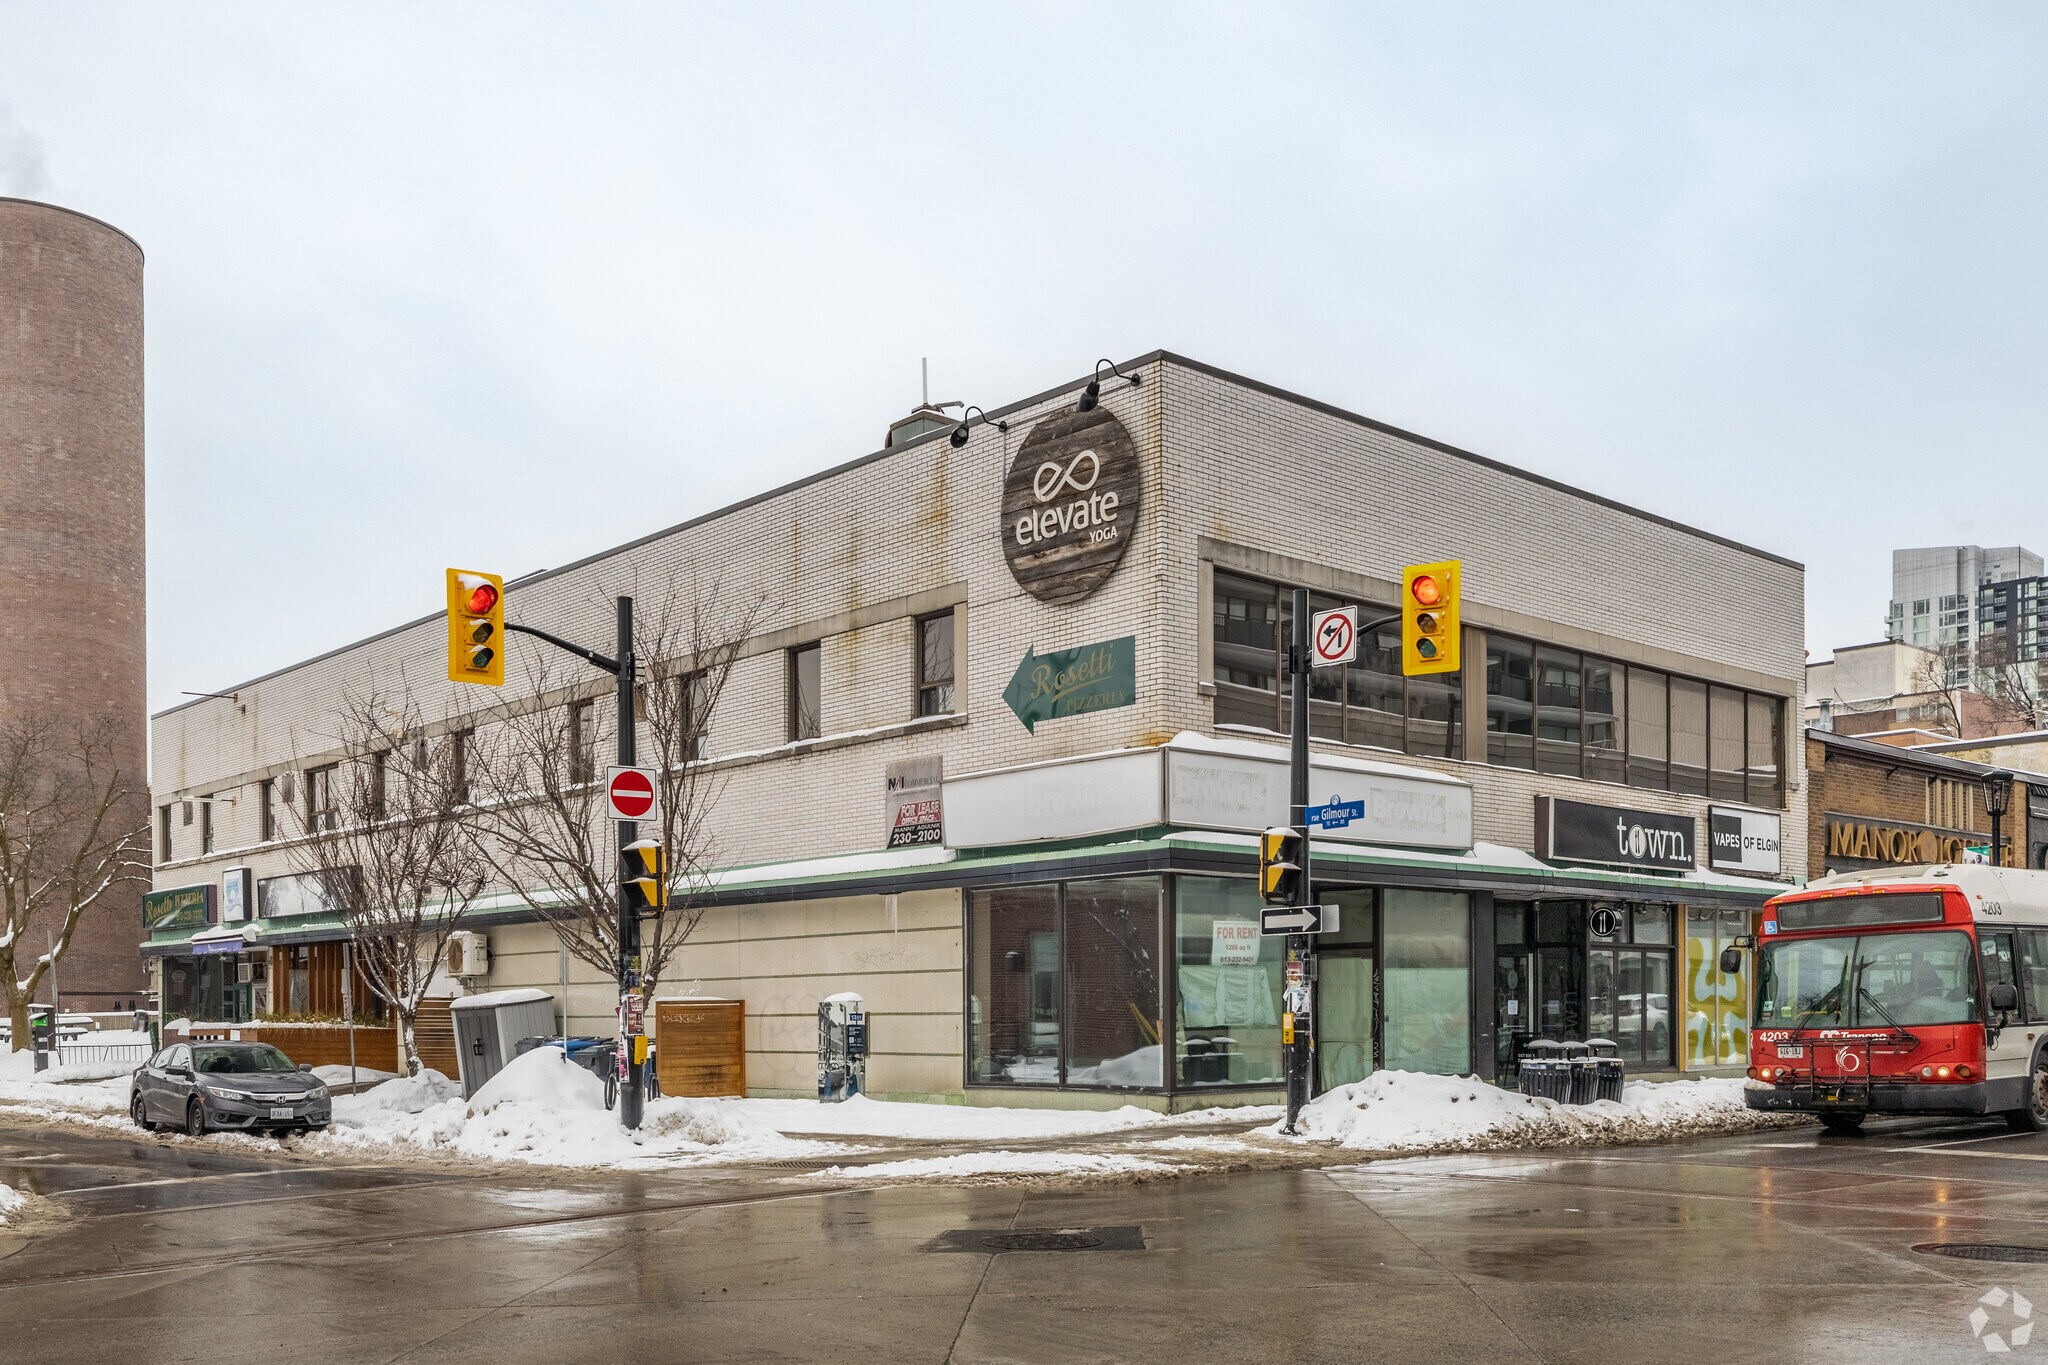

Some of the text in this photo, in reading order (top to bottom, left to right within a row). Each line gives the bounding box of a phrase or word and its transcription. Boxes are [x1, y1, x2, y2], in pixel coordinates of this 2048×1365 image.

[1016, 490, 1119, 546] elevate
[1089, 525, 1119, 544] YOGA
[1030, 643, 1116, 699] Rosetti
[1066, 690, 1125, 713] PIZZERIA
[901, 801, 939, 817] FOR LEASE
[1311, 807, 1359, 822] rue Gilmour St.
[893, 829, 941, 845] 230-2100
[1713, 831, 1780, 852] VAPES OF ELGIN
[1829, 820, 1918, 863] MANOR
[1981, 901, 2002, 915] 4203
[1216, 927, 1258, 940] FOR RENT
[1760, 1032, 1789, 1042] 4203
